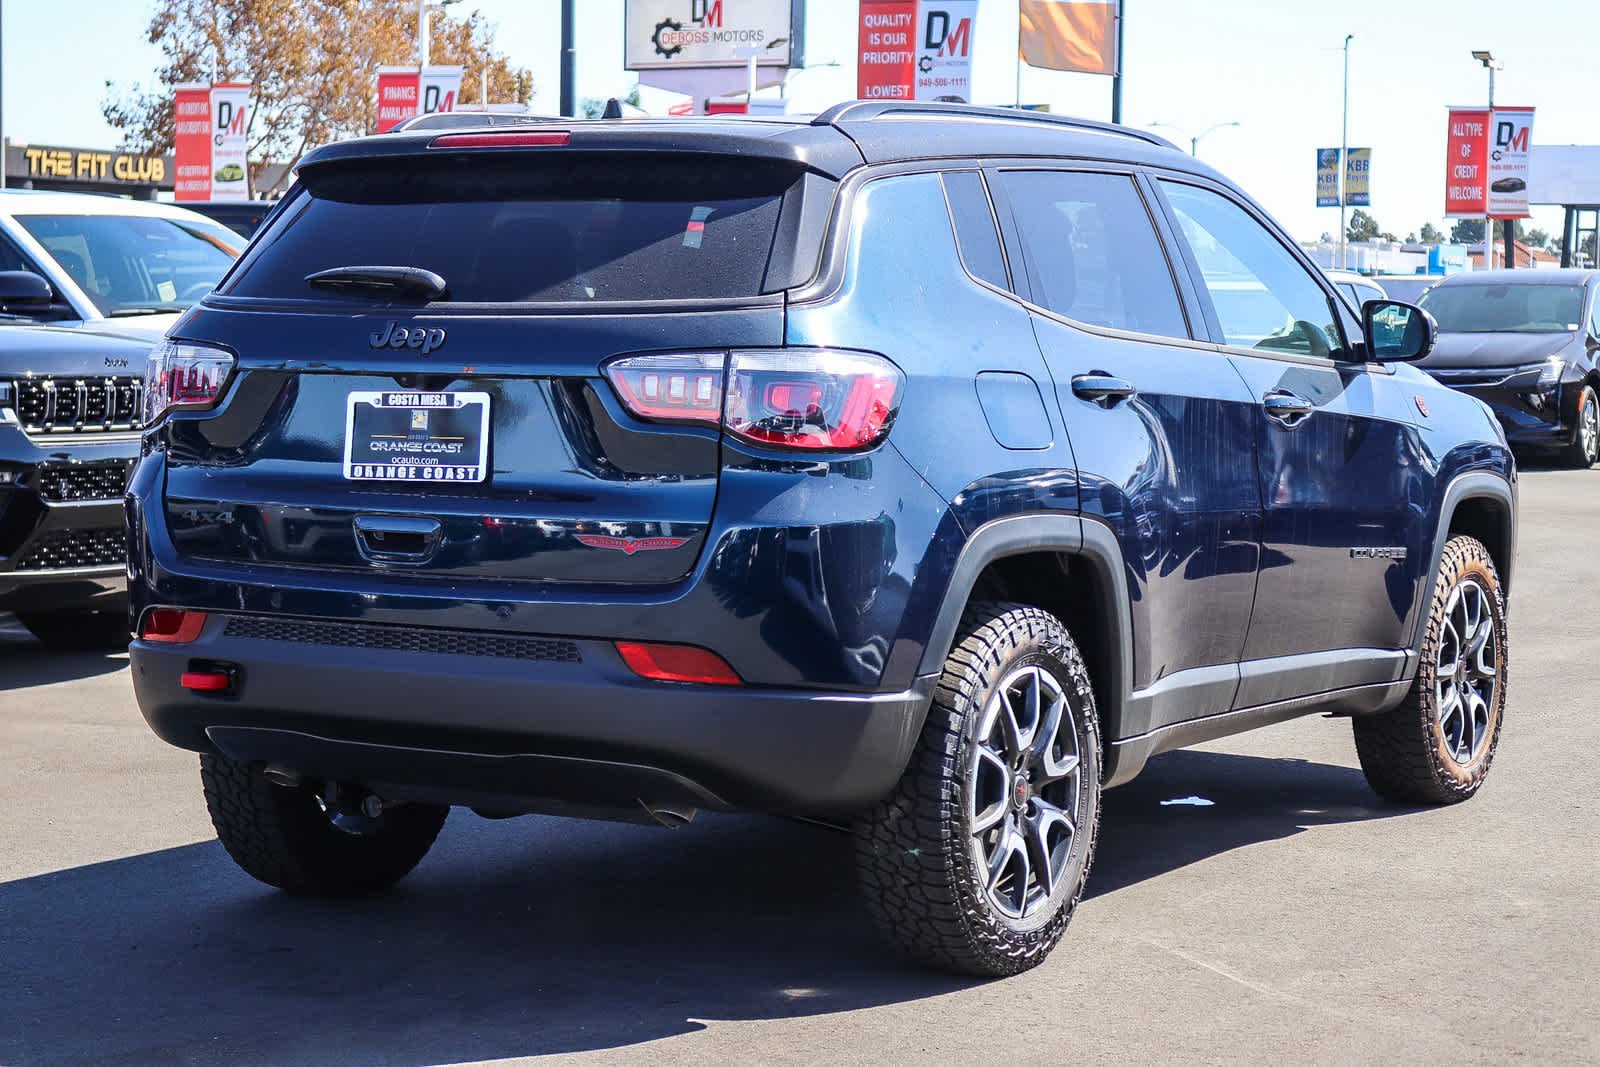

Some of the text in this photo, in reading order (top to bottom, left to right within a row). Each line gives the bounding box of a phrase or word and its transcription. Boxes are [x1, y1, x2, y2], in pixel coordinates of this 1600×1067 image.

[865, 13, 912, 28] QUALITY
[662, 30, 765, 44] DEBOSS MOTORS
[870, 32, 907, 45] IS OUR
[863, 51, 914, 64] PRIORITY
[384, 86, 416, 100] FINANCE
[865, 85, 910, 97] LOWEST
[1453, 123, 1483, 136] ALL TYPE
[1461, 143, 1471, 157] OF
[26, 149, 73, 176] THE
[77, 152, 112, 177] FIT
[114, 156, 165, 181] CLUB
[1454, 165, 1478, 178] CREDIT
[1449, 185, 1482, 200] WELCOME
[369, 319, 447, 354] Jeep
[388, 394, 447, 406] COSTA MESA
[391, 456, 439, 465] ocauto.com
[353, 465, 476, 480] ORANGE COAST
